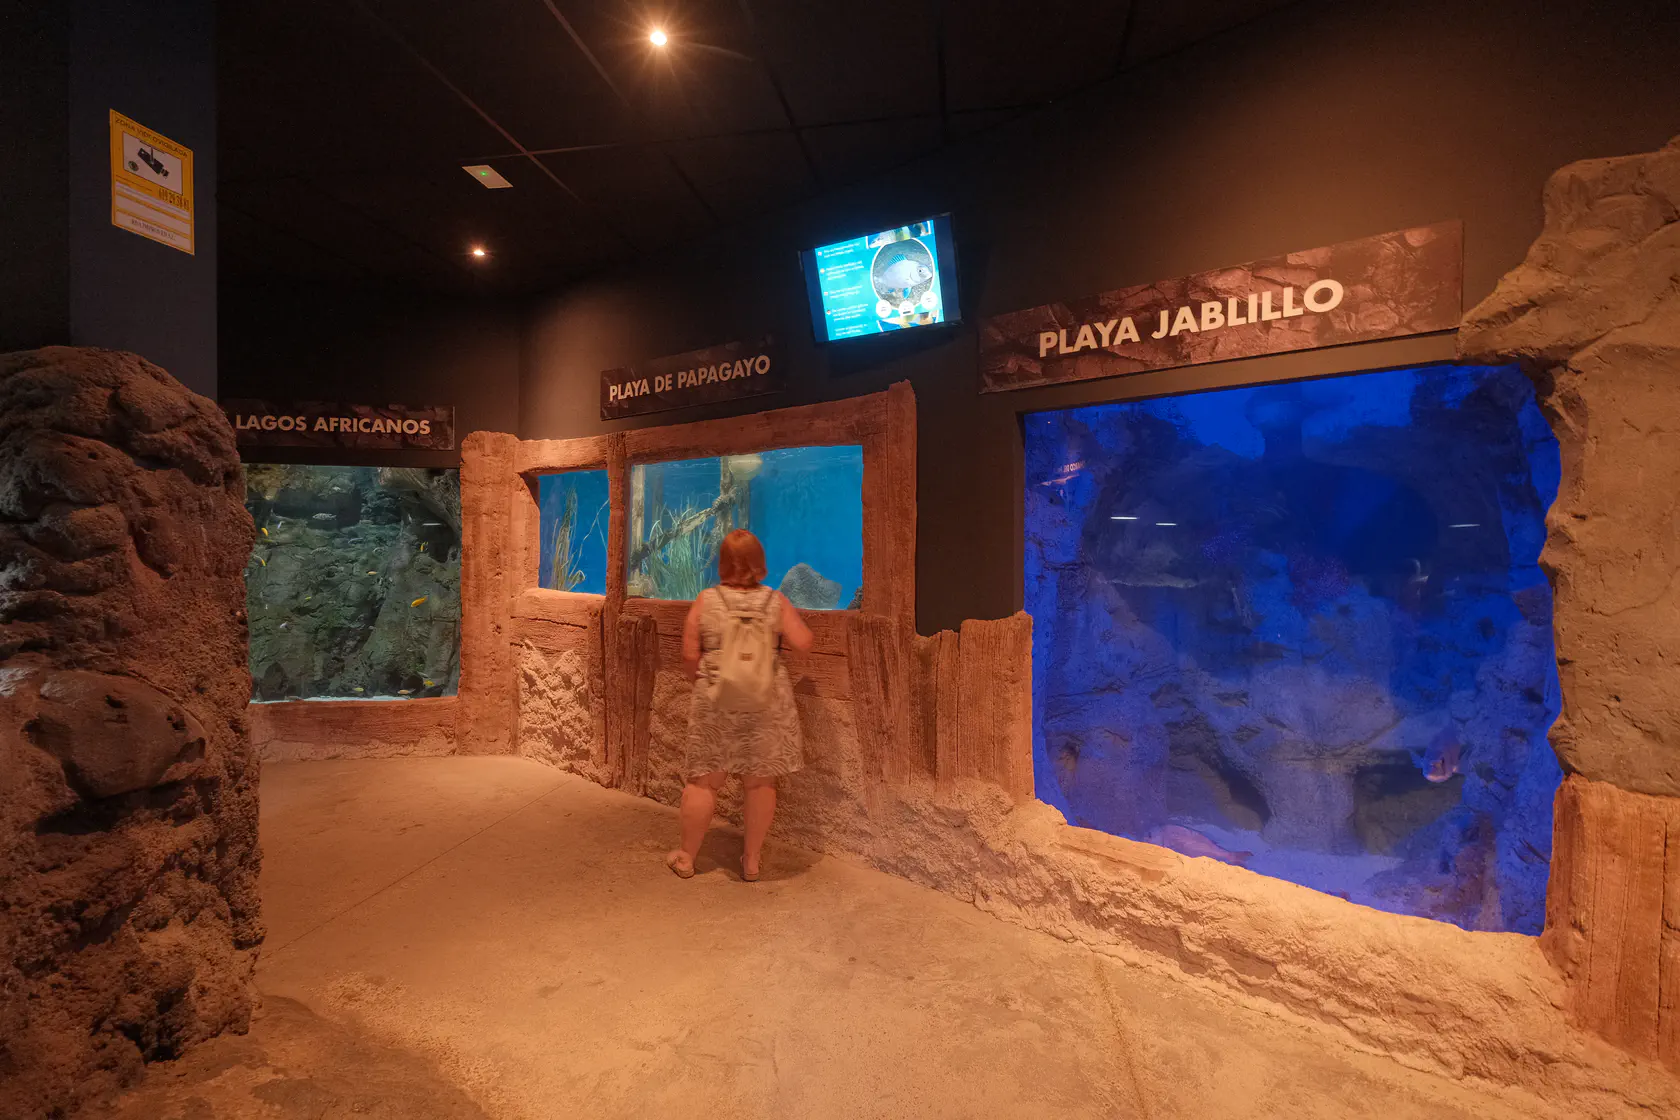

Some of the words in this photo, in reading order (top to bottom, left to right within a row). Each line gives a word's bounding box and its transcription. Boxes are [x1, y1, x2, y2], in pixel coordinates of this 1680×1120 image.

[1038, 316, 1141, 358] PLAYA
[1151, 278, 1344, 339] JABLILLO
[609, 378, 650, 402] PLAYA
[654, 373, 673, 393] DE
[677, 354, 771, 389] PAPAGAYO
[235, 414, 307, 431] LAGOS
[313, 416, 431, 435] AFRICANOS
